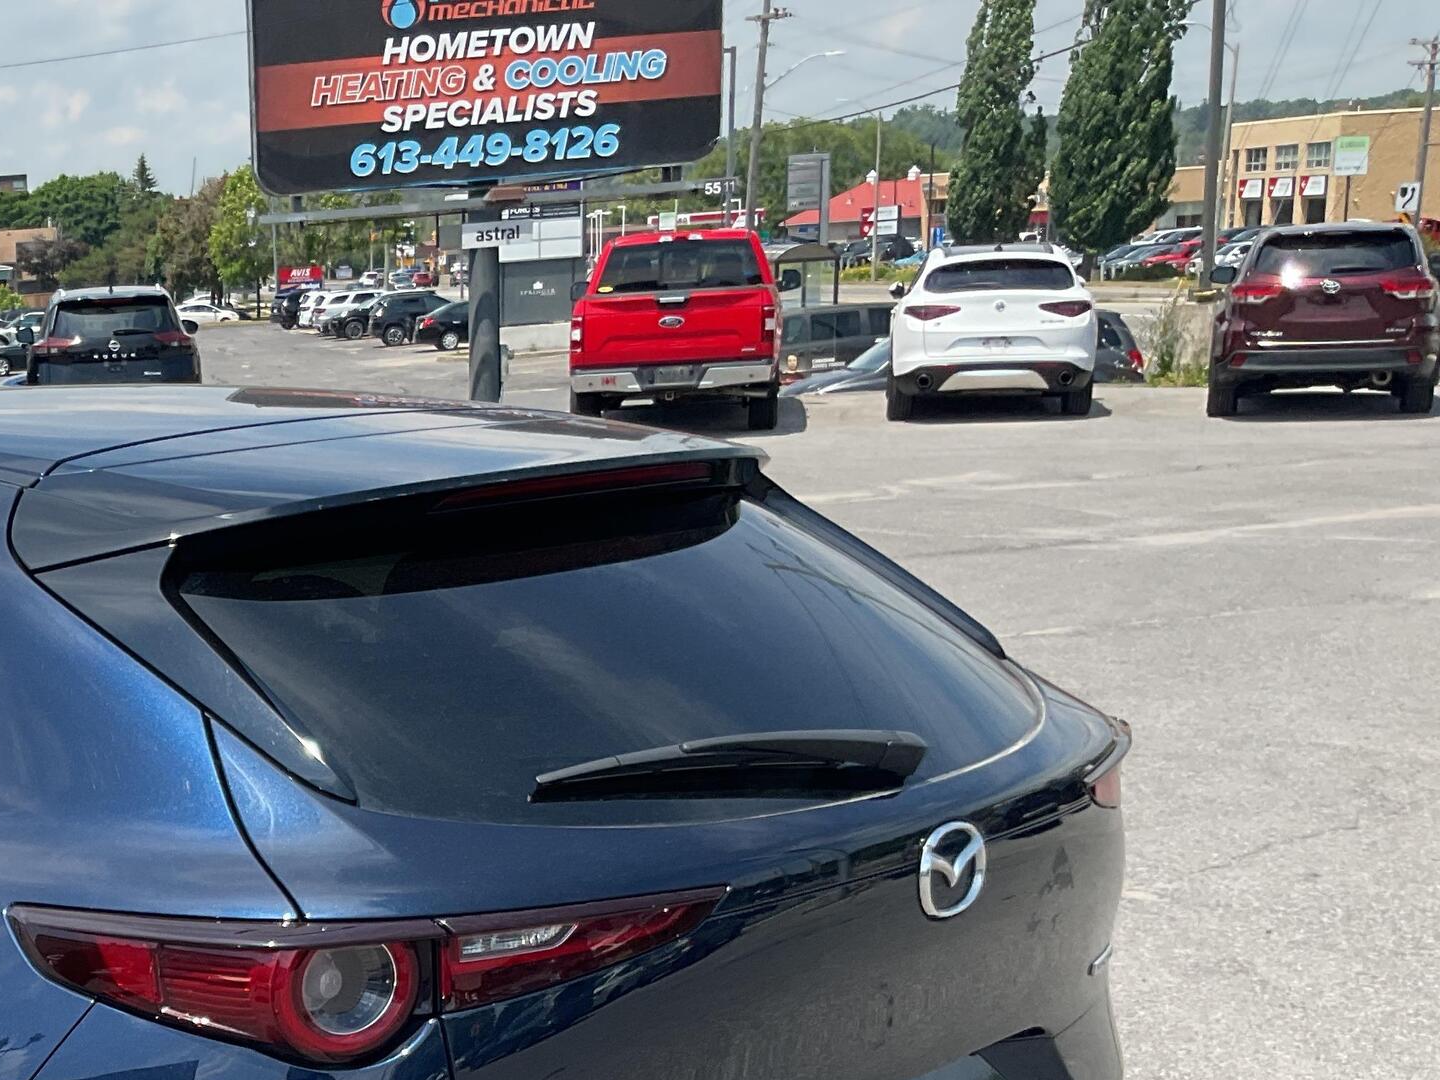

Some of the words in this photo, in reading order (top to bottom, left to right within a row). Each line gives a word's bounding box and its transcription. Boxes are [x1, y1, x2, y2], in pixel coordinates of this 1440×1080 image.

[382, 22, 596, 66] HOMETOWN
[311, 65, 466, 107] HEATING
[472, 64, 496, 91] &
[505, 49, 668, 90] COOLING
[381, 89, 598, 133] SPECIALISTS
[350, 123, 621, 178] 613-449-8126
[476, 225, 520, 242] astral
[290, 268, 311, 277] AVIS
